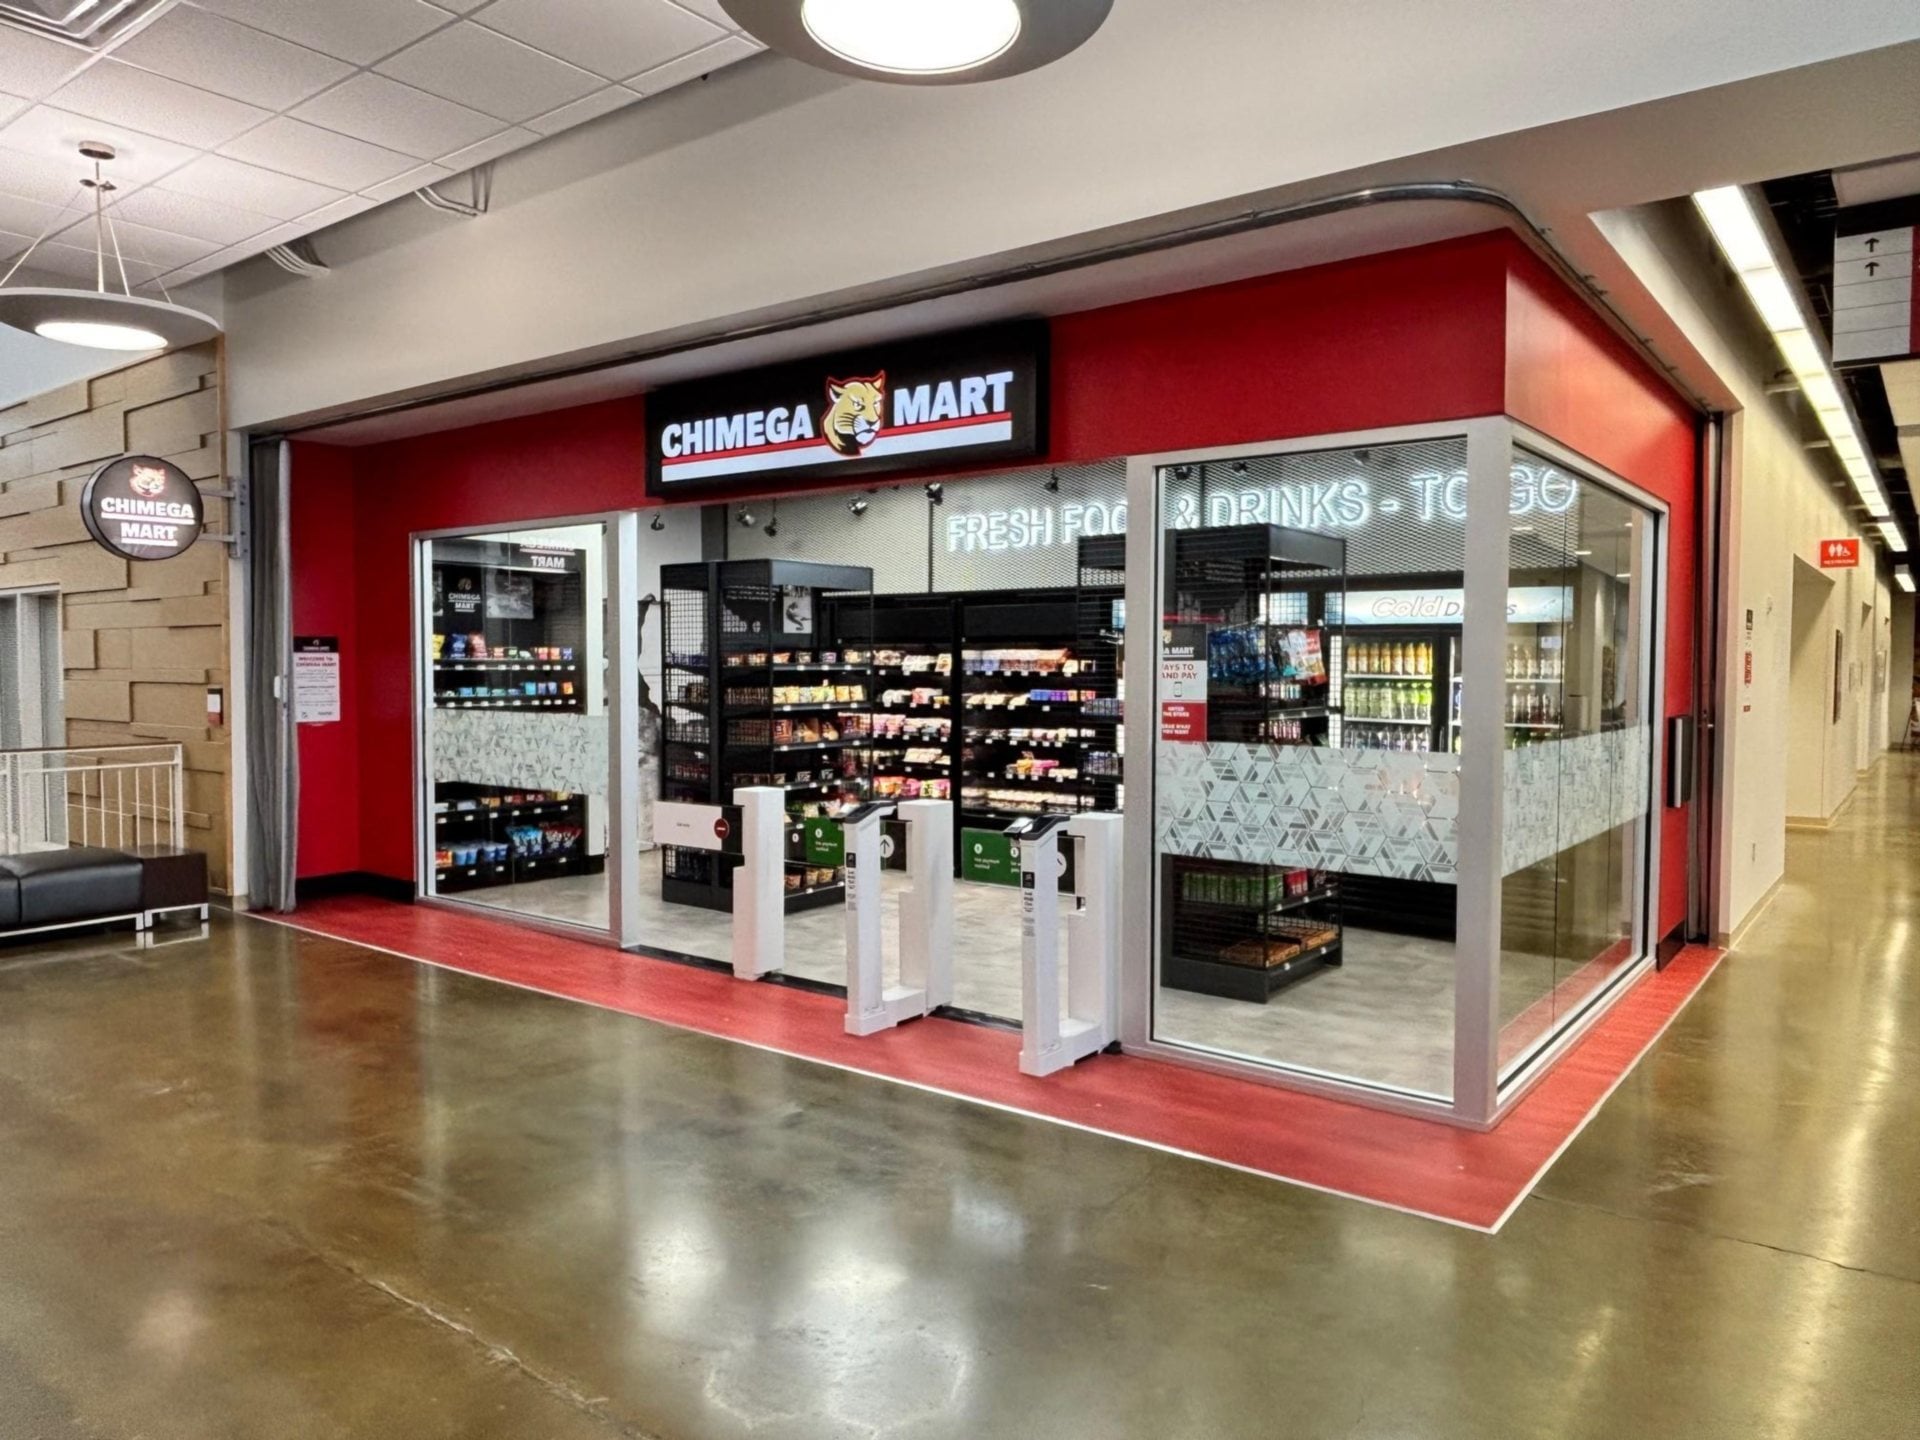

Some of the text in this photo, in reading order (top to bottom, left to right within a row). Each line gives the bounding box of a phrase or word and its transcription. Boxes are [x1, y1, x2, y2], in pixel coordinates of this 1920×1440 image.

[661, 371, 1013, 458] CHIMEGA MART
[100, 497, 195, 518] CHIMEGA
[946, 508, 1053, 552] FRESH
[1210, 479, 1370, 529] DRINKS
[120, 523, 178, 540] MART
[1372, 596, 1444, 617] Cold
